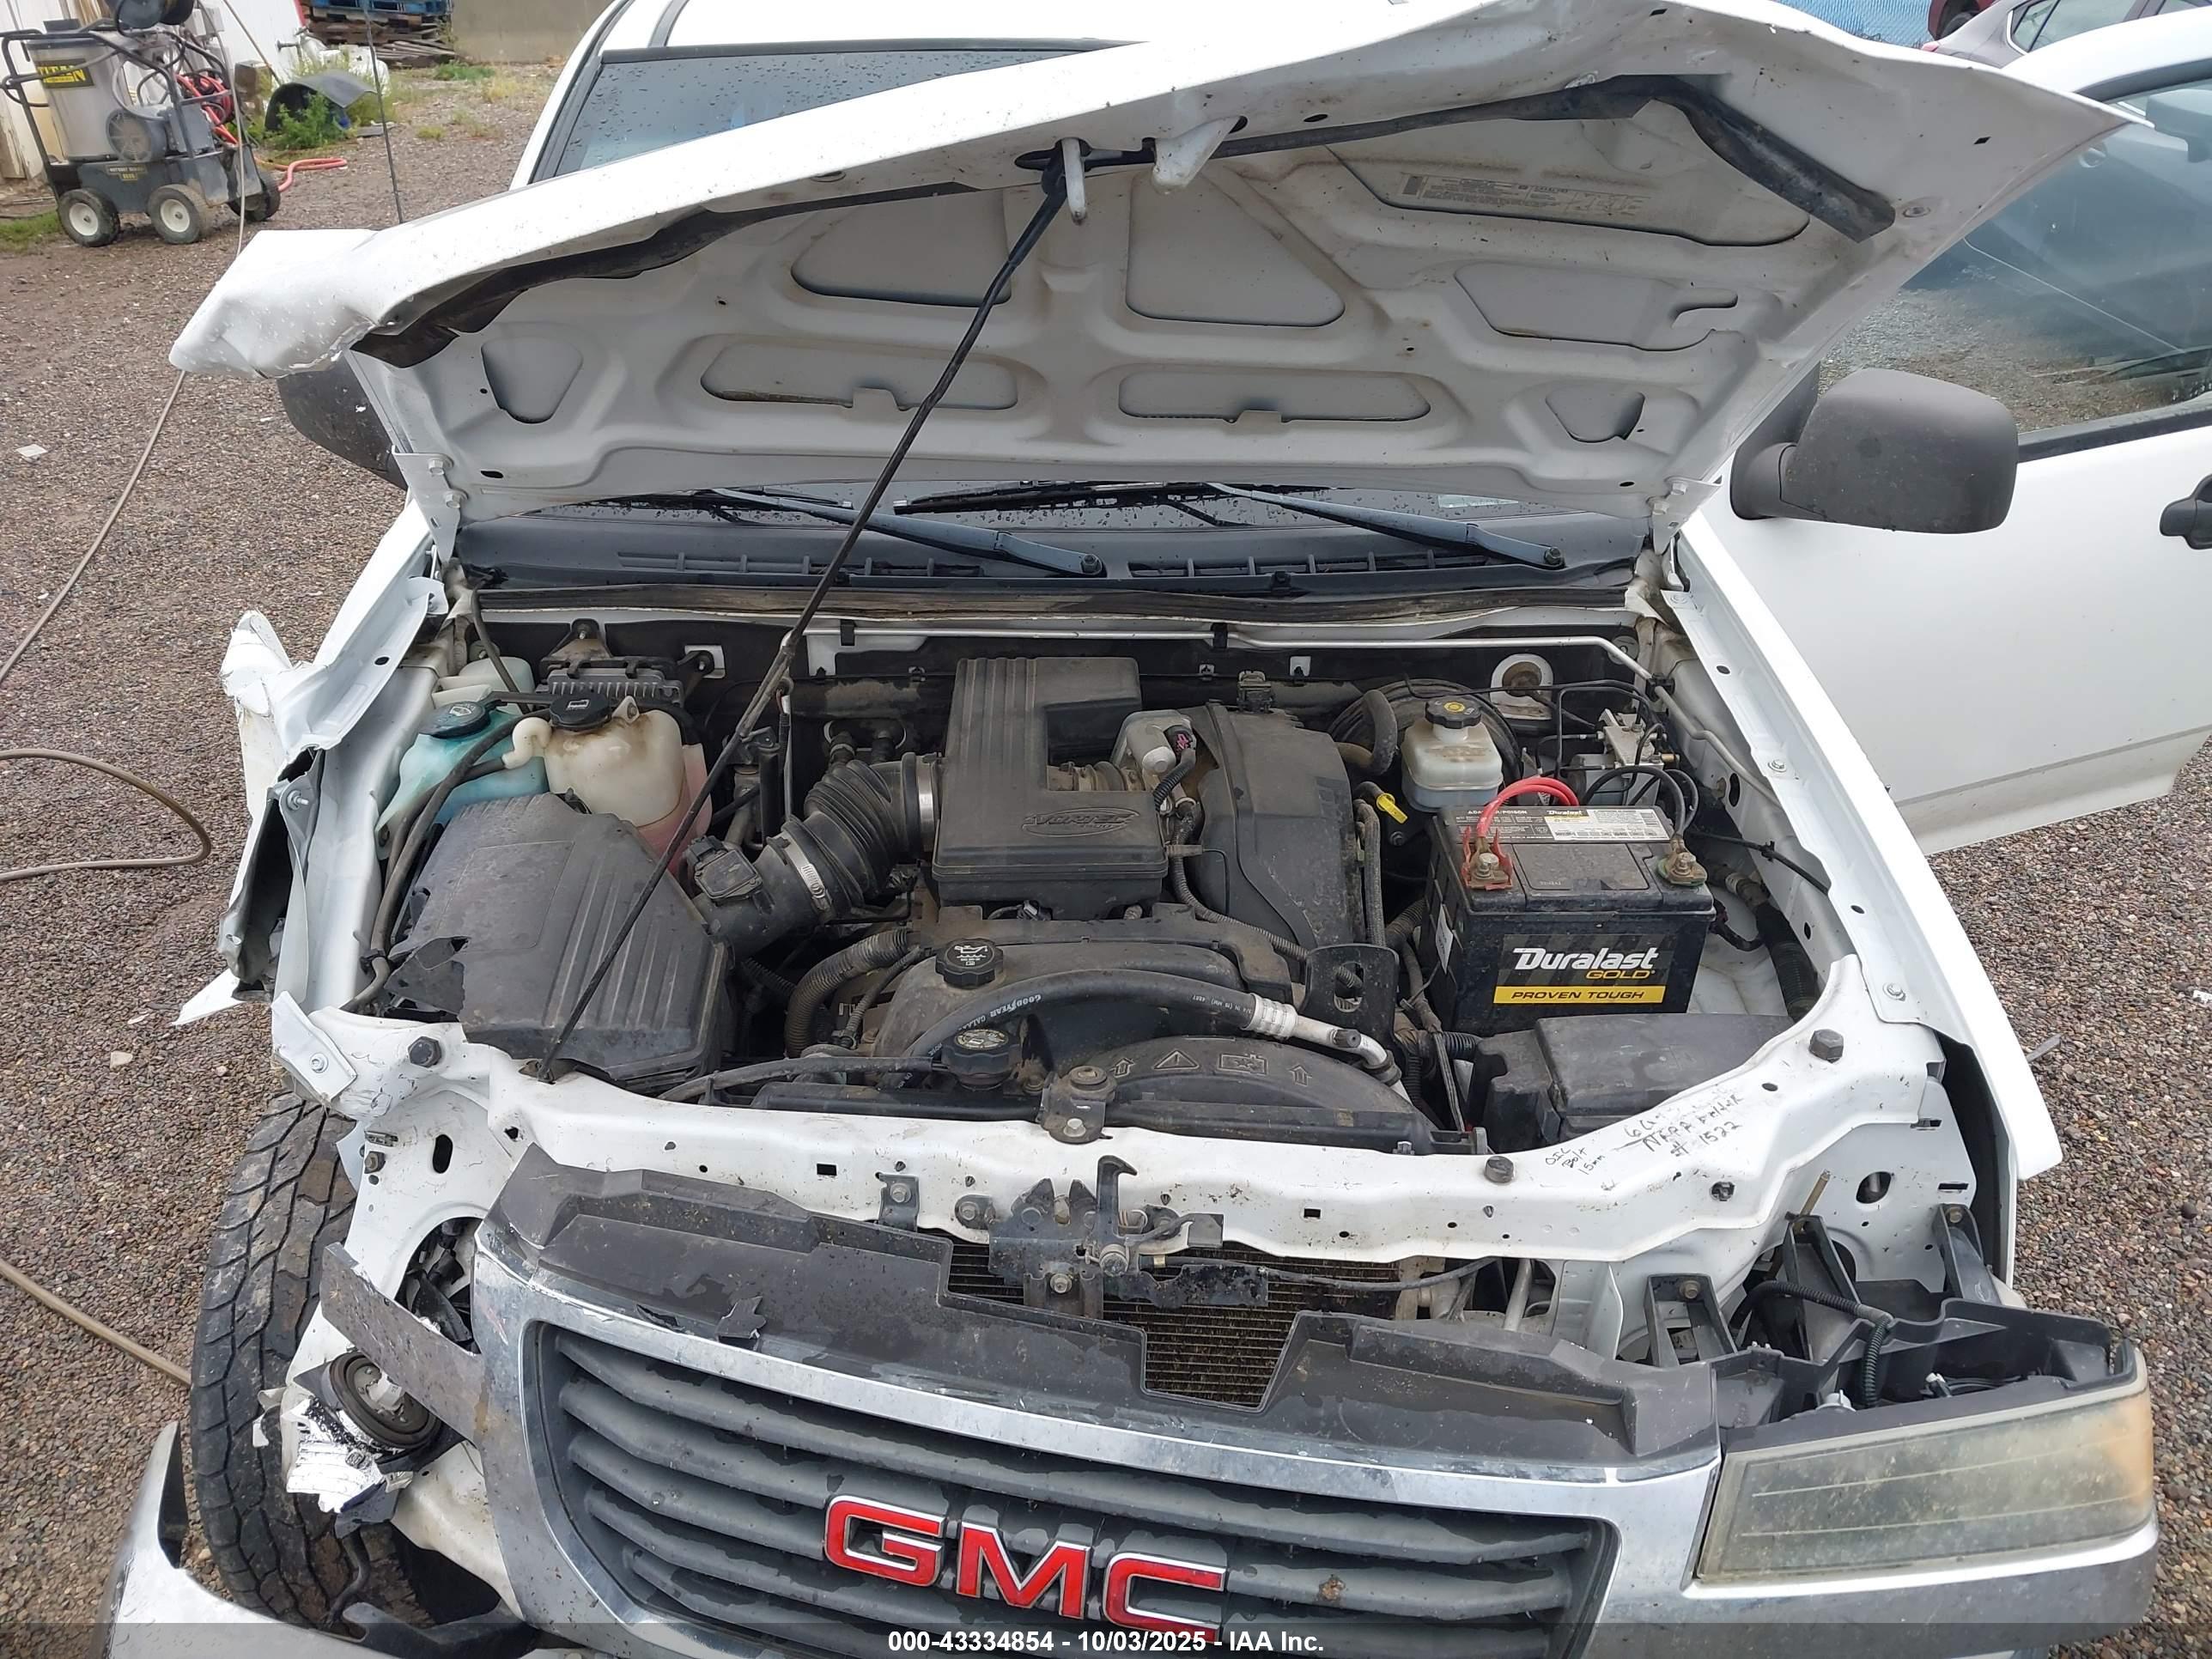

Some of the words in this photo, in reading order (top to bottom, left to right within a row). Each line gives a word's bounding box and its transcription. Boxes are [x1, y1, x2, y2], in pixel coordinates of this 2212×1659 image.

[1512, 947, 1659, 970] Duralast
[1585, 969, 1650, 980] GOLD
[989, 994, 1042, 1018] GOODYEAR
[1510, 991, 1582, 1000] PROVEN
[1588, 991, 1646, 1000] TOUGH
[823, 1494, 1227, 1644] GMC
